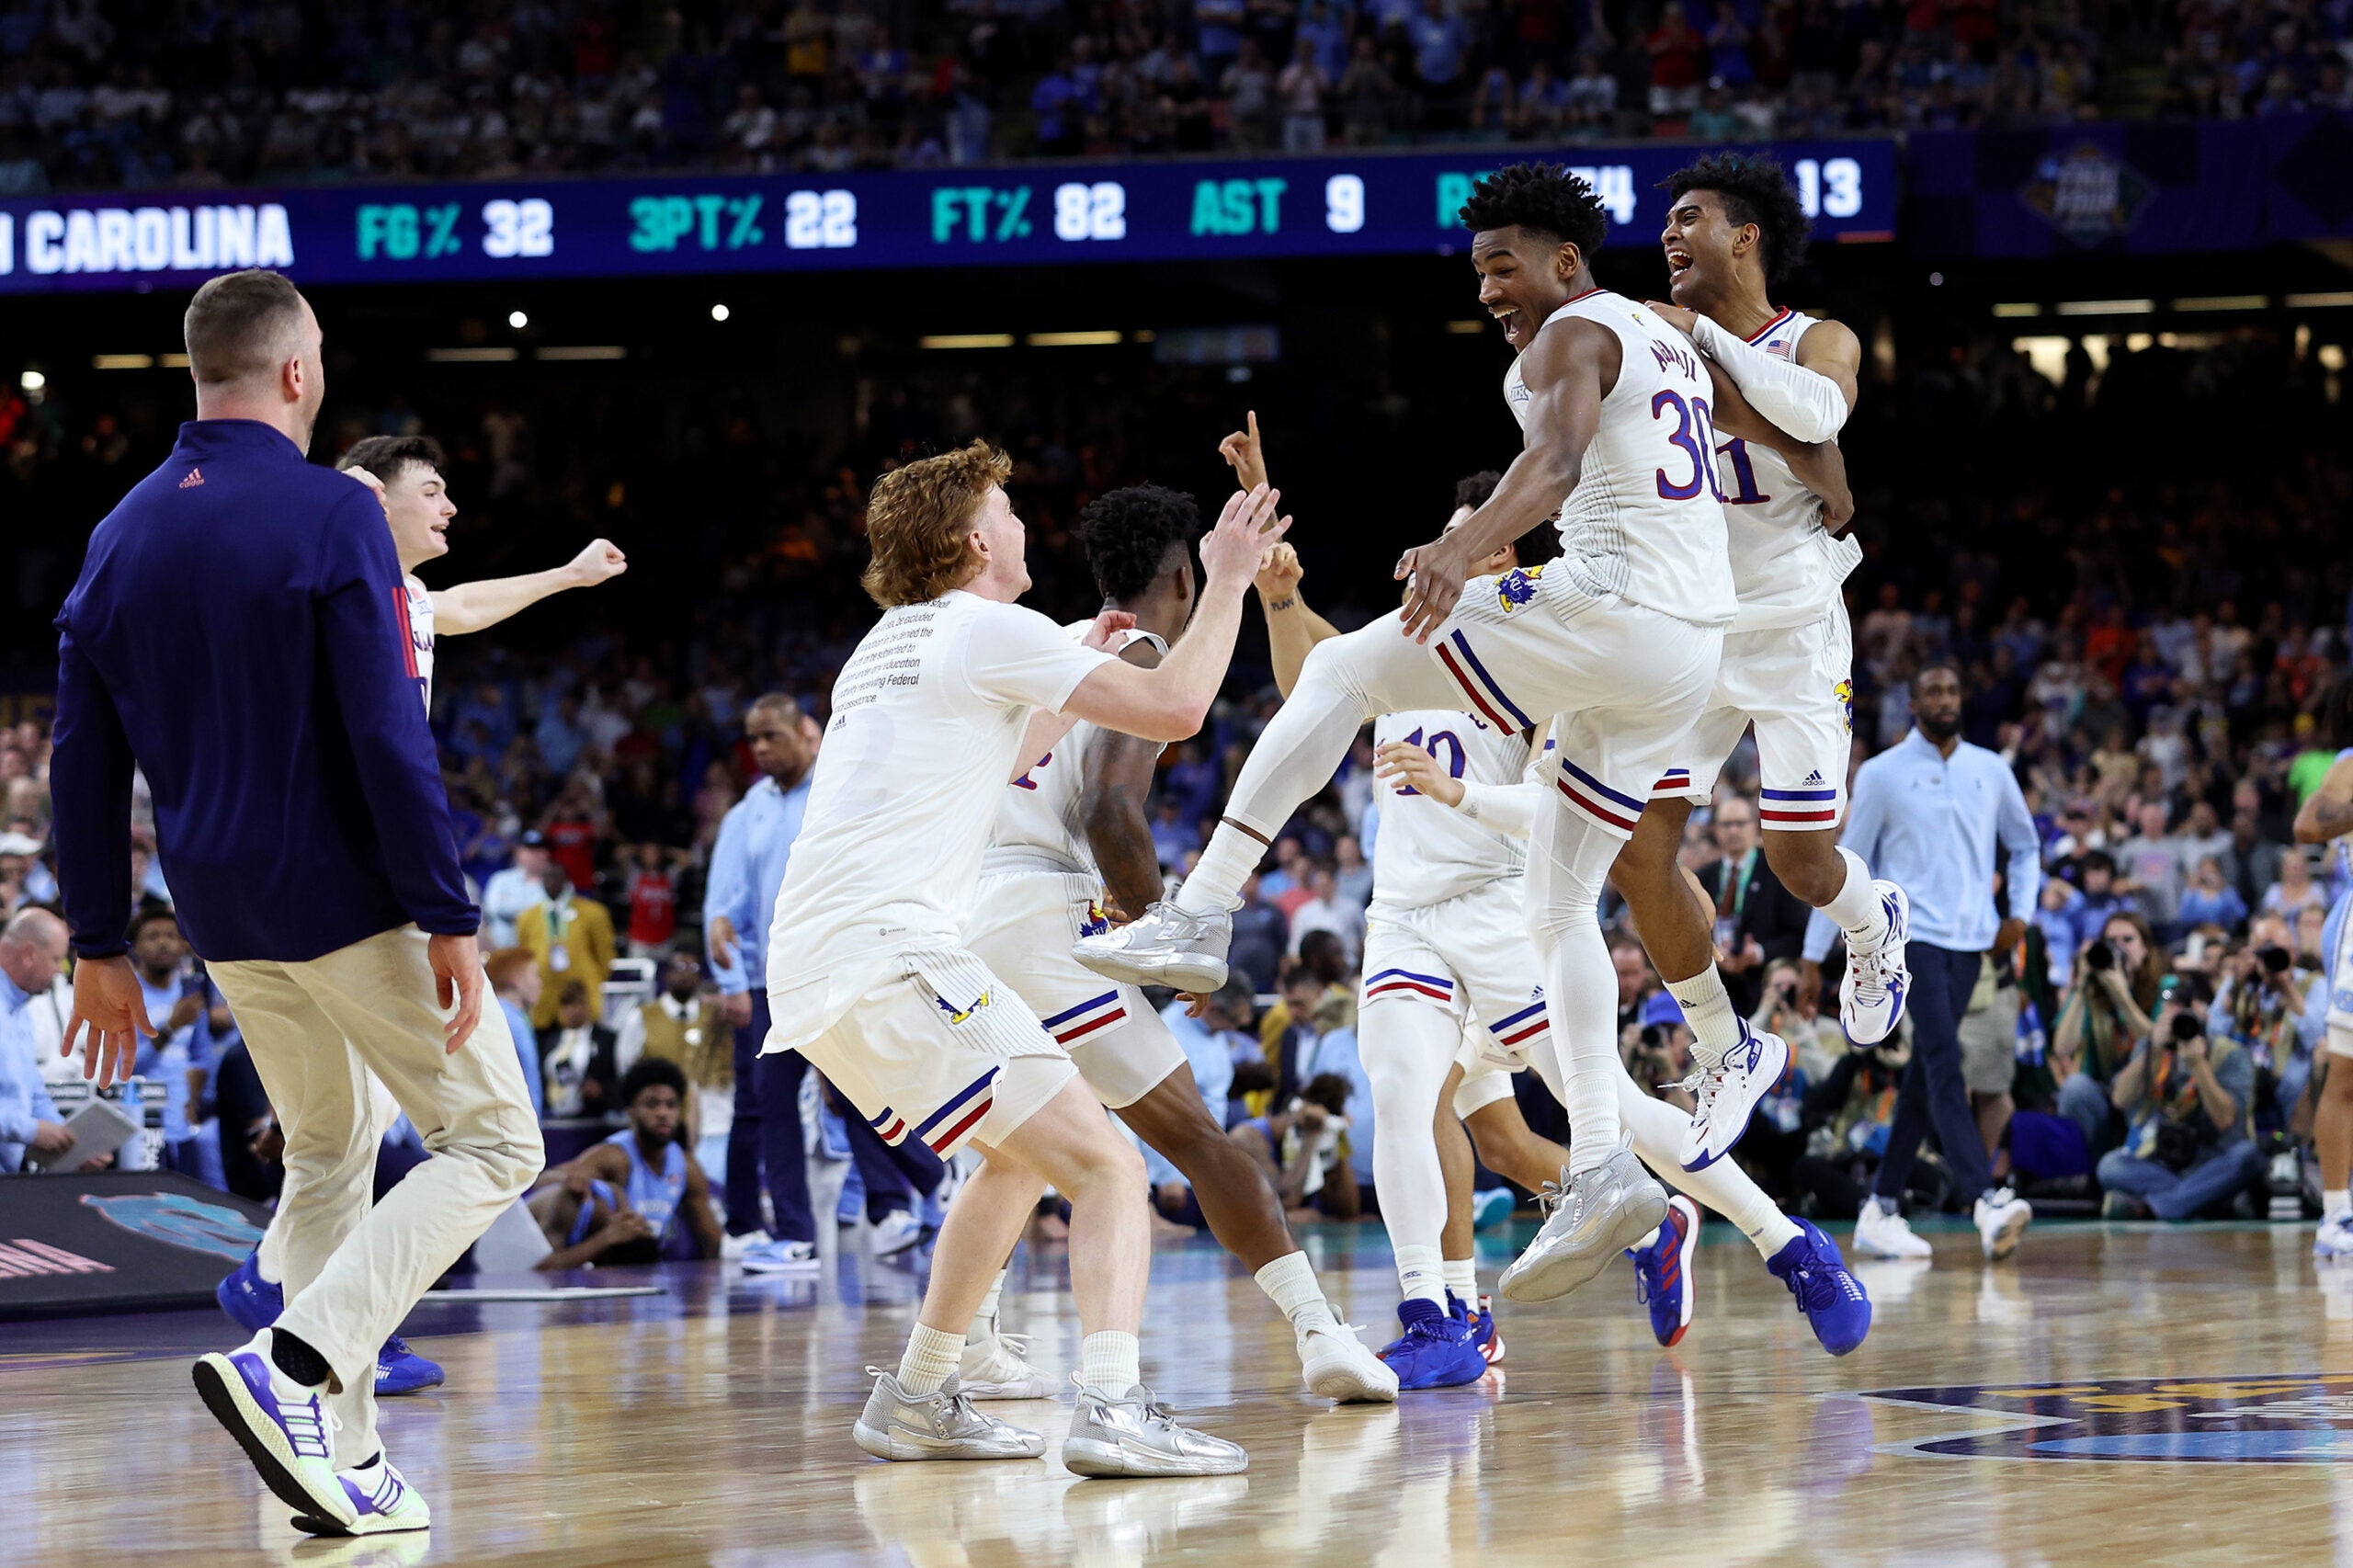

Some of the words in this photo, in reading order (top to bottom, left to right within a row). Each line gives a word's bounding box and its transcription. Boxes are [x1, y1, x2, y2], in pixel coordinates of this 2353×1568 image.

[26, 204, 293, 274] CAROLINA
[358, 204, 461, 259] FG%
[483, 199, 553, 257] 32
[630, 195, 764, 252] 3PT%
[785, 190, 858, 249] 22
[932, 187, 1032, 244] FT%
[1054, 182, 1126, 241] 82
[1190, 177, 1287, 235] AST
[1325, 175, 1365, 233] 9
[1795, 159, 1863, 217] 13
[1652, 389, 1722, 504] 30
[919, 627, 934, 638] the
[886, 674, 920, 686] Federal
